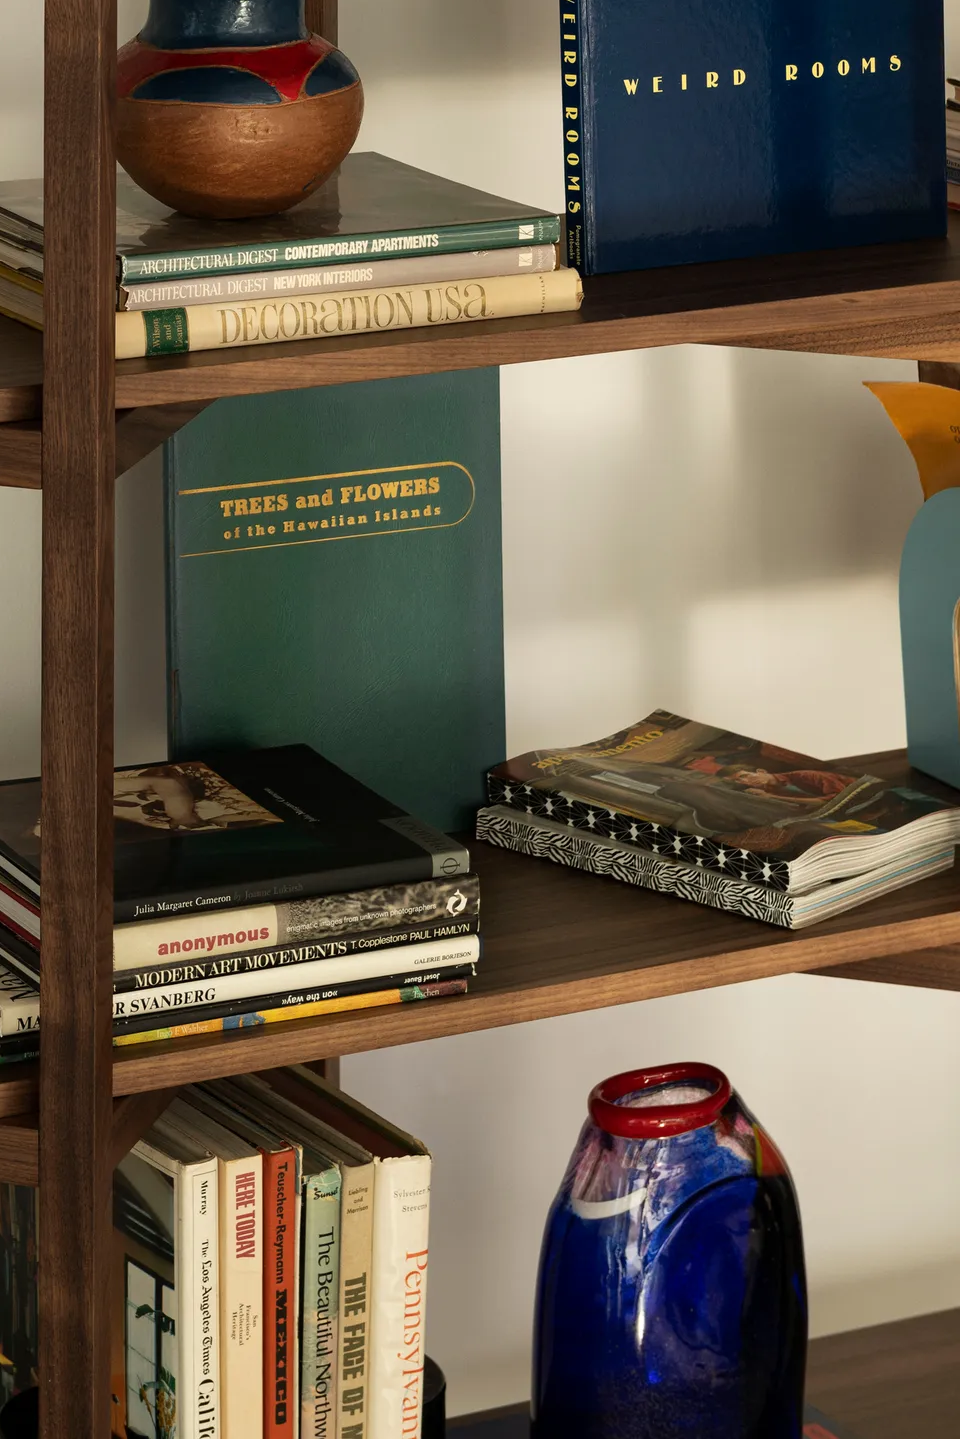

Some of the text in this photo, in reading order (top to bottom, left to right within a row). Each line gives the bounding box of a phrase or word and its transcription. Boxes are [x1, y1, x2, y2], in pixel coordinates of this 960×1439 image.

[623, 54, 902, 96] WEIRD ROOMS
[565, 106, 581, 214] ROOMS
[140, 233, 439, 275] ARCHITECTURAL DIGEST CONTEMPORARY APARTMENTS
[128, 267, 373, 304] ARCHITECTURAL DIGEST NEW YORK INTERIORS
[152, 317, 161, 347] Wilson
[221, 476, 440, 518] TREES and FLOWERS
[223, 504, 441, 540] of the Hawaiian Islands
[134, 889, 271, 917] Julia Margaret Cameron Joanne
[286, 903, 437, 934] enigmatic images from unknown photographers
[134, 963, 206, 989] MODERN
[208, 958, 242, 977] ART
[245, 940, 347, 973] MOVEMENTS
[350, 940, 358, 950] T.
[358, 933, 408, 950] Copplestone
[410, 931, 432, 942] PAUL
[434, 923, 470, 937] HAMLYN
[157, 927, 270, 956] anonymous
[414, 955, 441, 965] GALERIE
[403, 972, 441, 984] Josef Bauer
[130, 987, 216, 1013] SVANBERG
[306, 992, 320, 1002] the
[413, 988, 440, 999] Taschen
[156, 1023, 209, 1039] Ingo Walther
[200, 1180, 208, 1216] Murray
[313, 1187, 339, 1200] Sunset
[348, 1186, 368, 1196] Liebling
[353, 1196, 363, 1204] and
[393, 1189, 426, 1199] Sylvester
[235, 1171, 255, 1259] HERE TODAY
[275, 1162, 288, 1284] Teuscher-Reymann
[346, 1205, 369, 1215] Morrison
[402, 1203, 427, 1213] Stevens
[201, 1239, 209, 1258] The
[201, 1260, 212, 1284] Los
[200, 1286, 213, 1335] Angeles
[314, 1226, 334, 1439] The Beautiful Northw
[342, 1272, 366, 1416] THE FACE OF
[398, 1249, 428, 1439] Pennsylvan
[202, 1336, 214, 1375] Times
[275, 1289, 287, 1425] MEXICO
